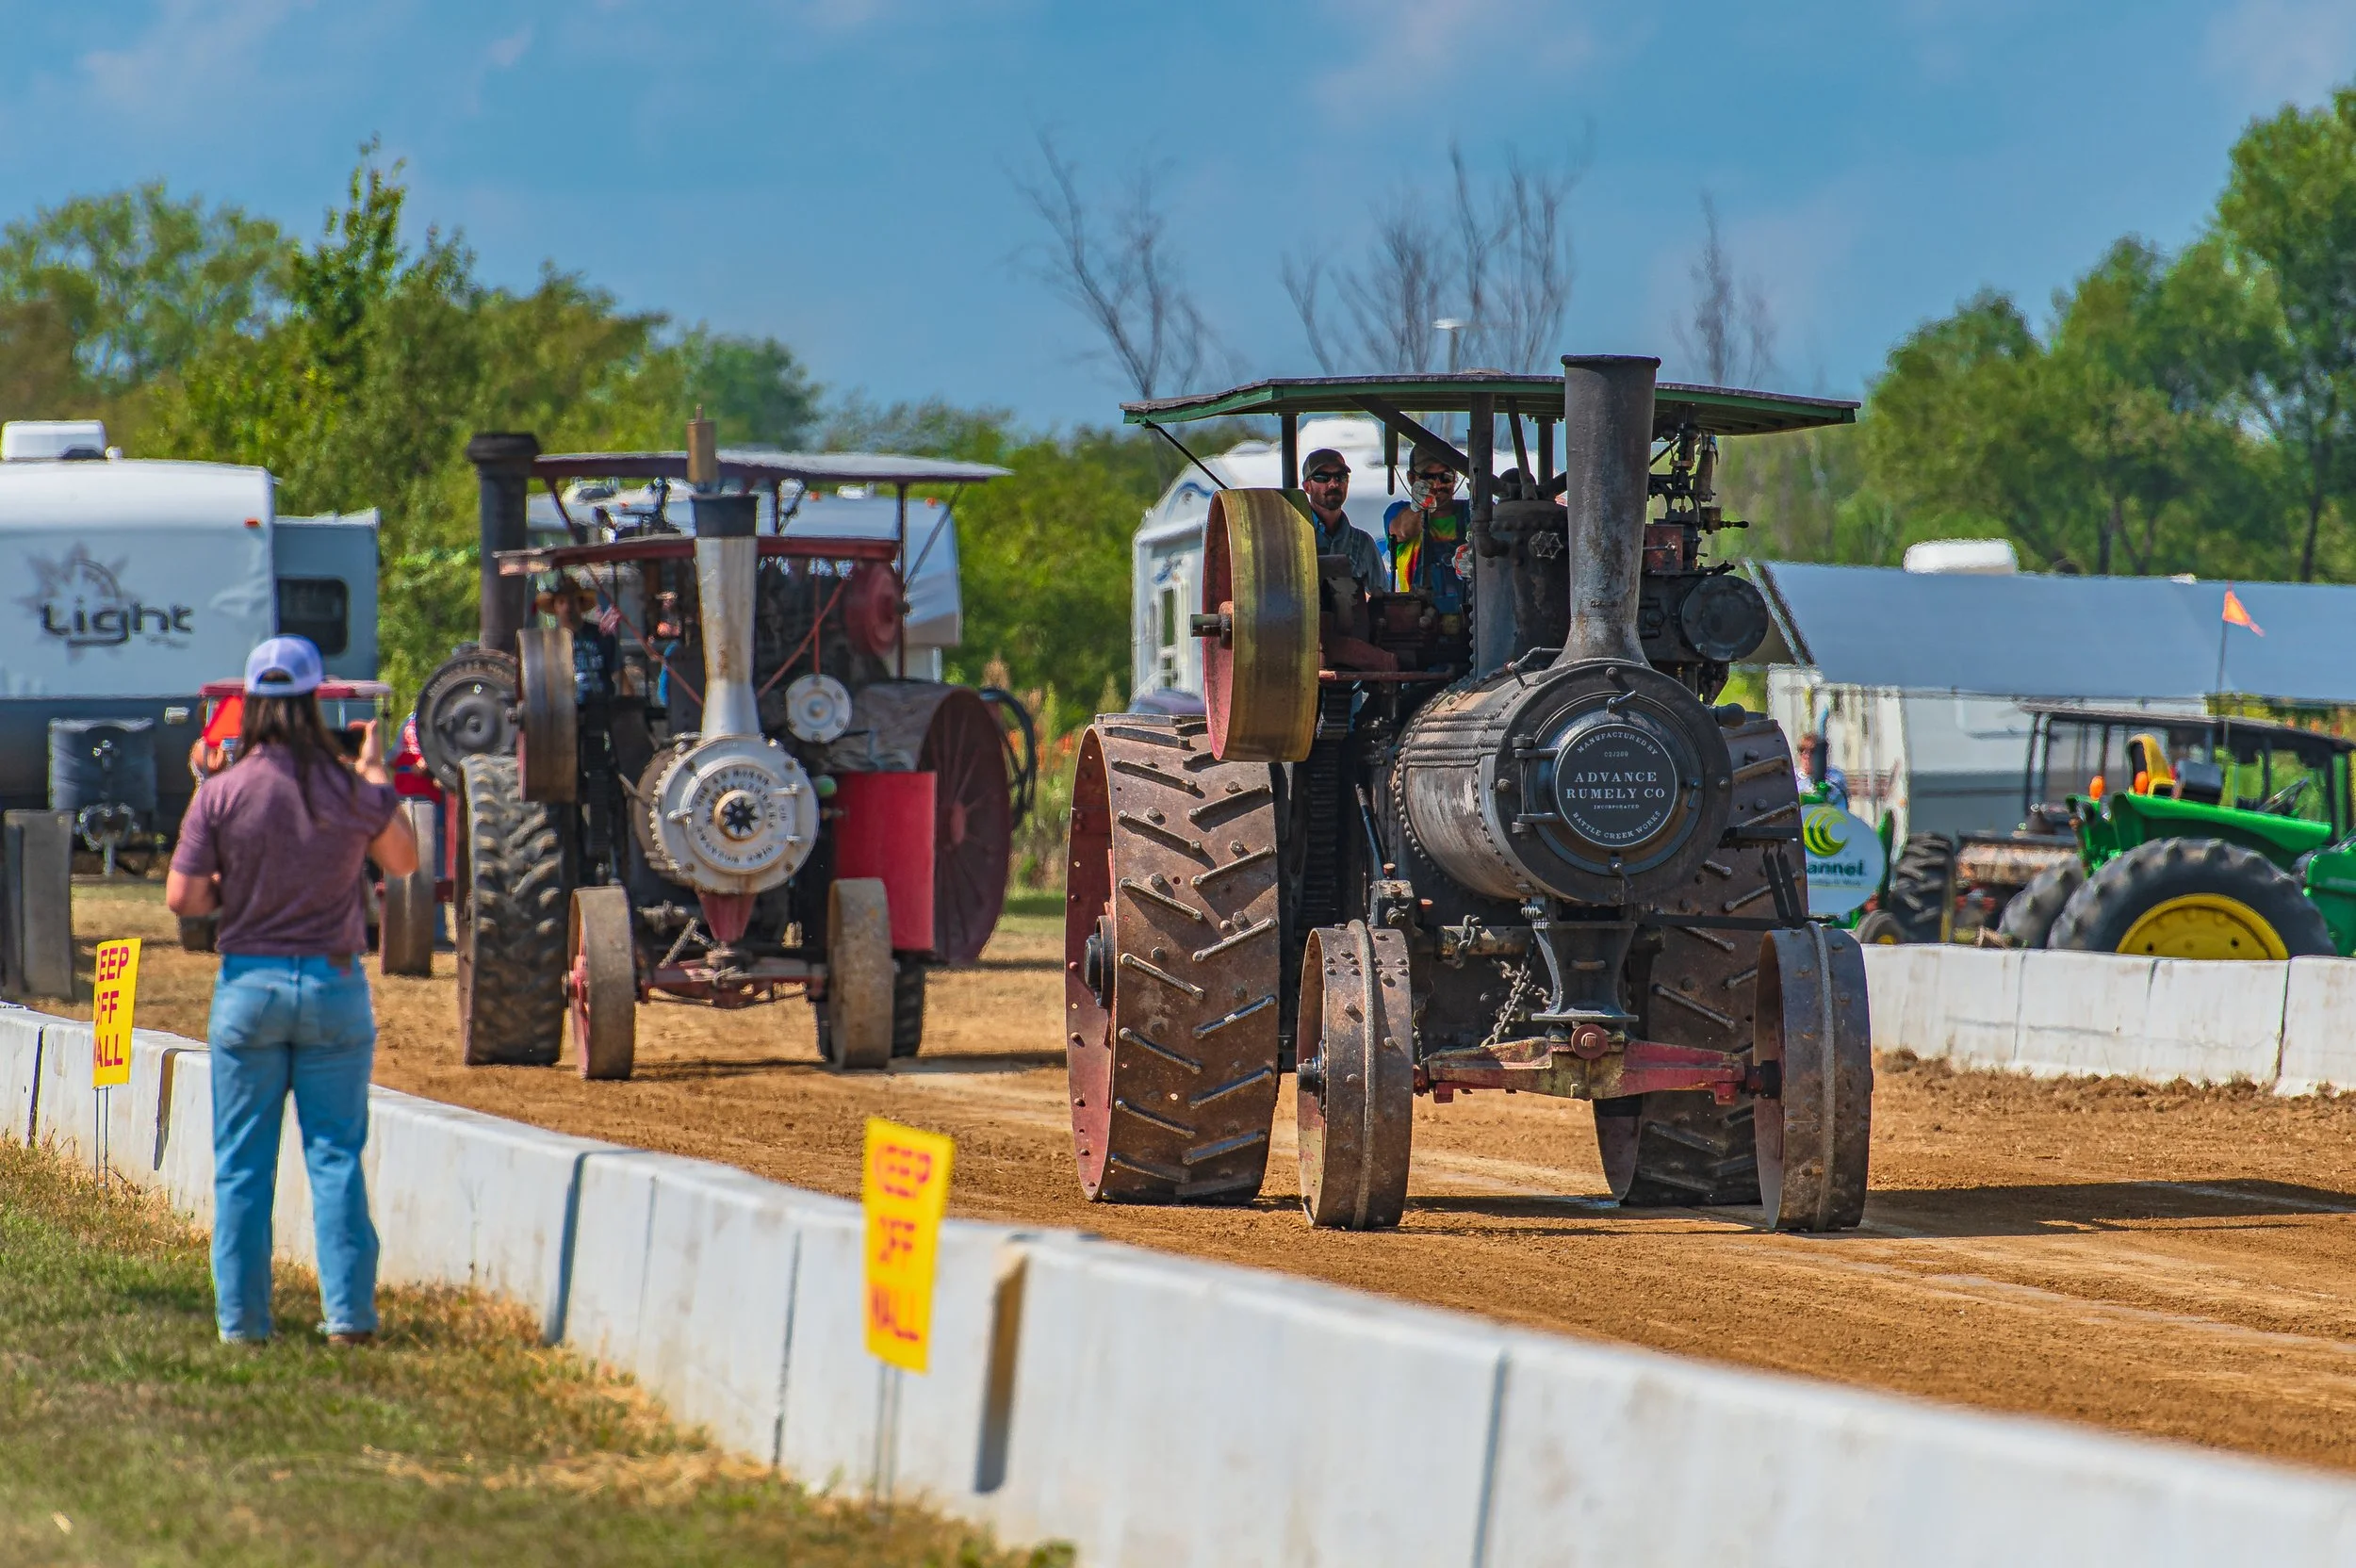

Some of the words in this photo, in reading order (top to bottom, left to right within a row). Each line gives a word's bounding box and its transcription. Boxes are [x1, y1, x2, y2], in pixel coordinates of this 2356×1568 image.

[40, 596, 193, 647] Light
[1577, 731, 1647, 754] MANUFACTURED
[1646, 743, 1659, 756] BY
[1574, 771, 1657, 783] ADVANCE
[1565, 788, 1637, 799] RUMELY
[1644, 788, 1665, 799] CO
[1572, 811, 1602, 837] BATTLE
[1603, 830, 1635, 840] CREEK
[1635, 810, 1661, 835] WORKS
[1807, 858, 1864, 876] annel
[98, 946, 130, 982] EEP
